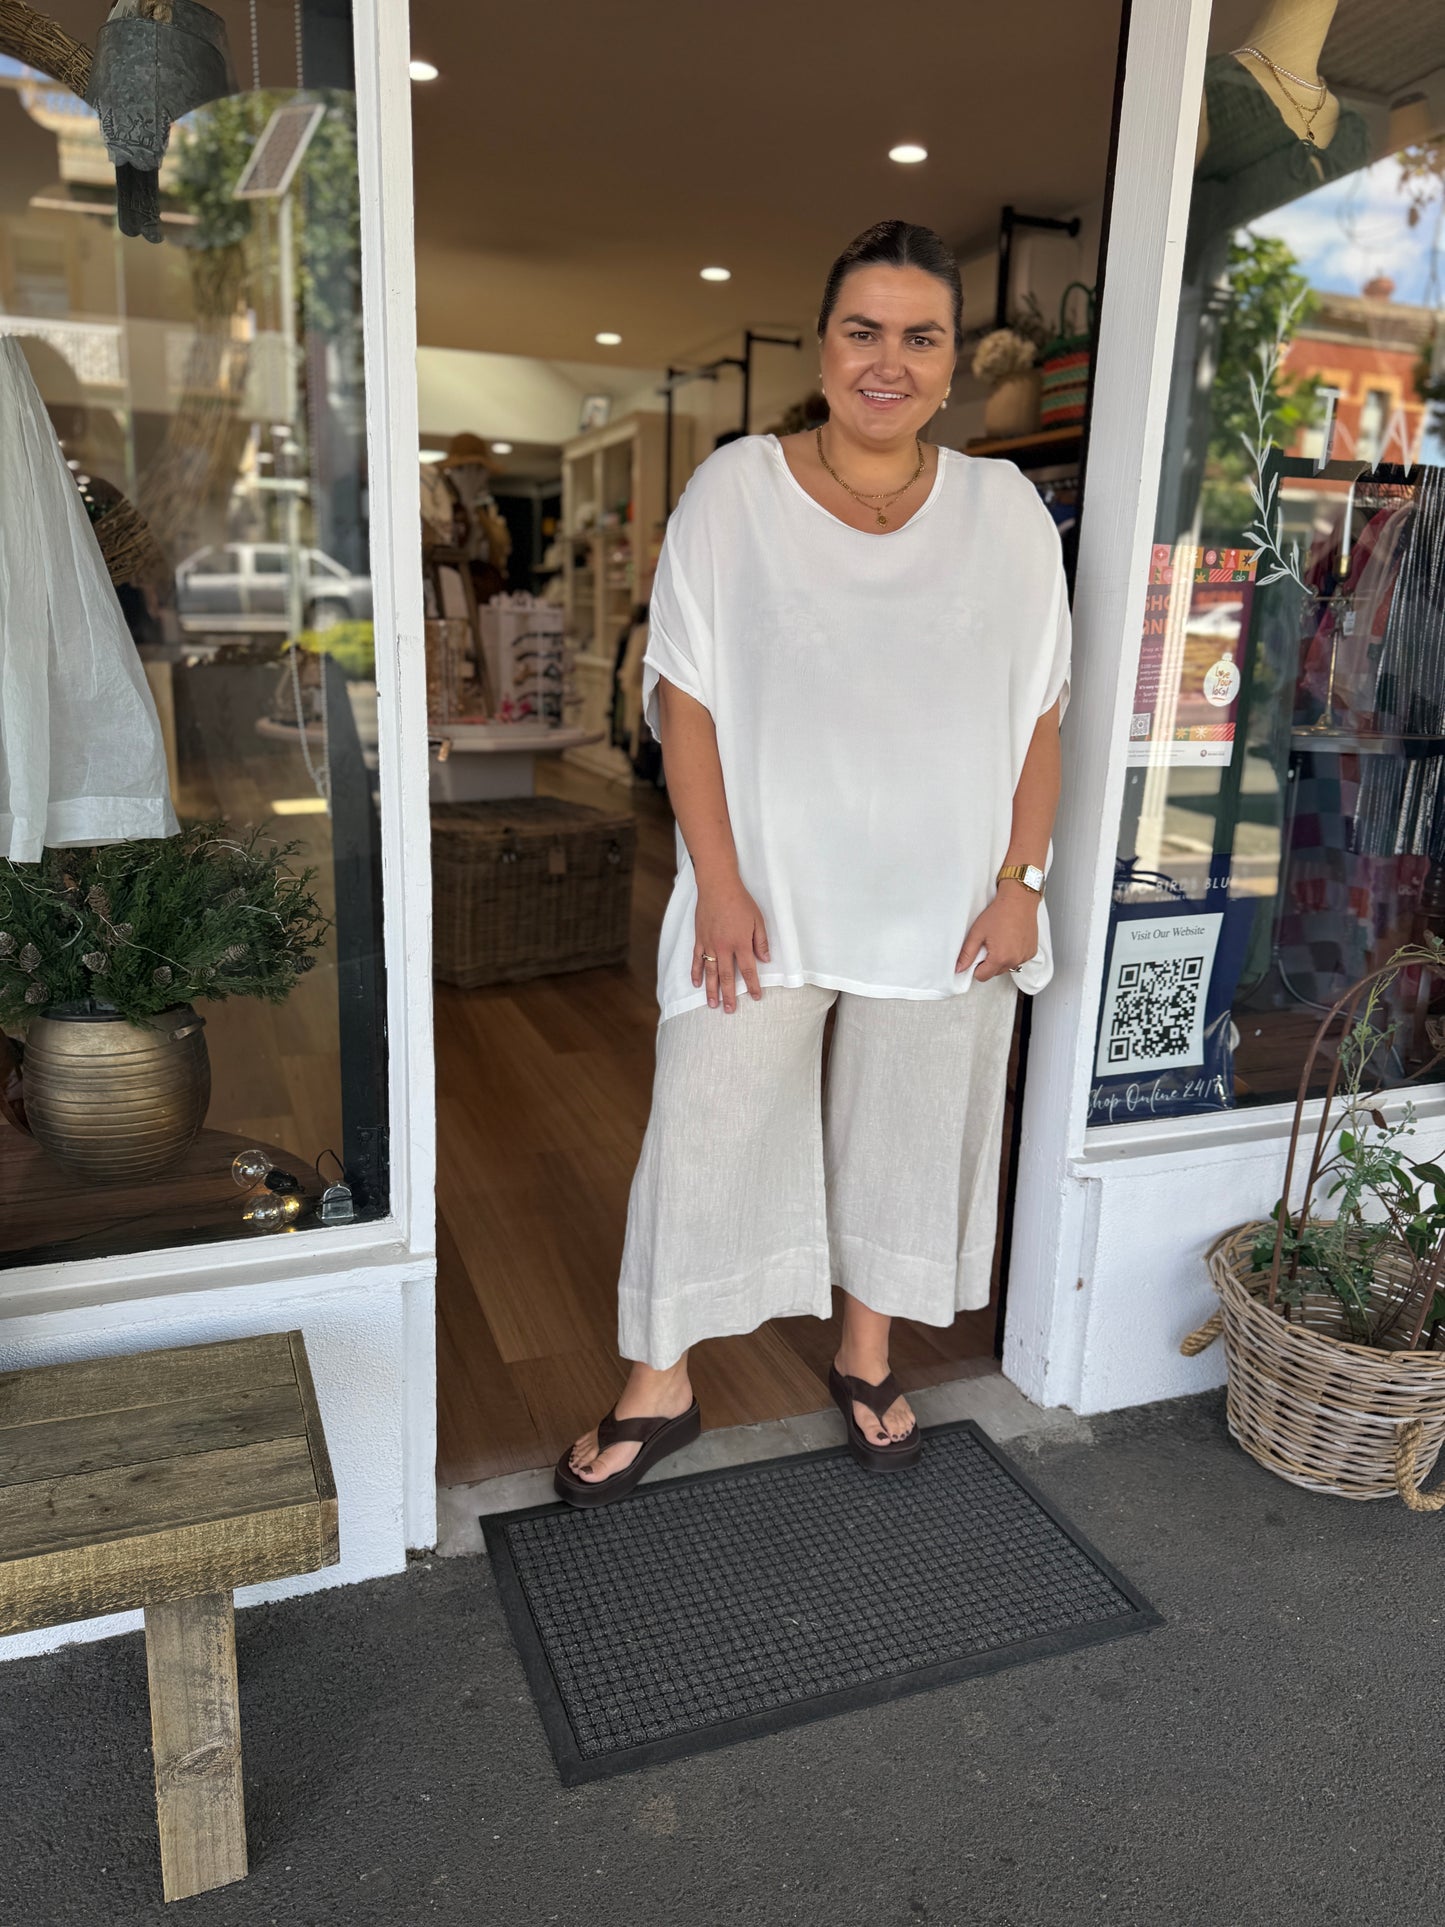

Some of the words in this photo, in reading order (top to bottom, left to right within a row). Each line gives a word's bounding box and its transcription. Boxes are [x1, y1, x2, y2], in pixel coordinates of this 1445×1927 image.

[1131, 929, 1151, 941] Visit
[1153, 928, 1170, 939] Our
[1172, 925, 1205, 937] Website
[1126, 1079, 1179, 1113] Online
